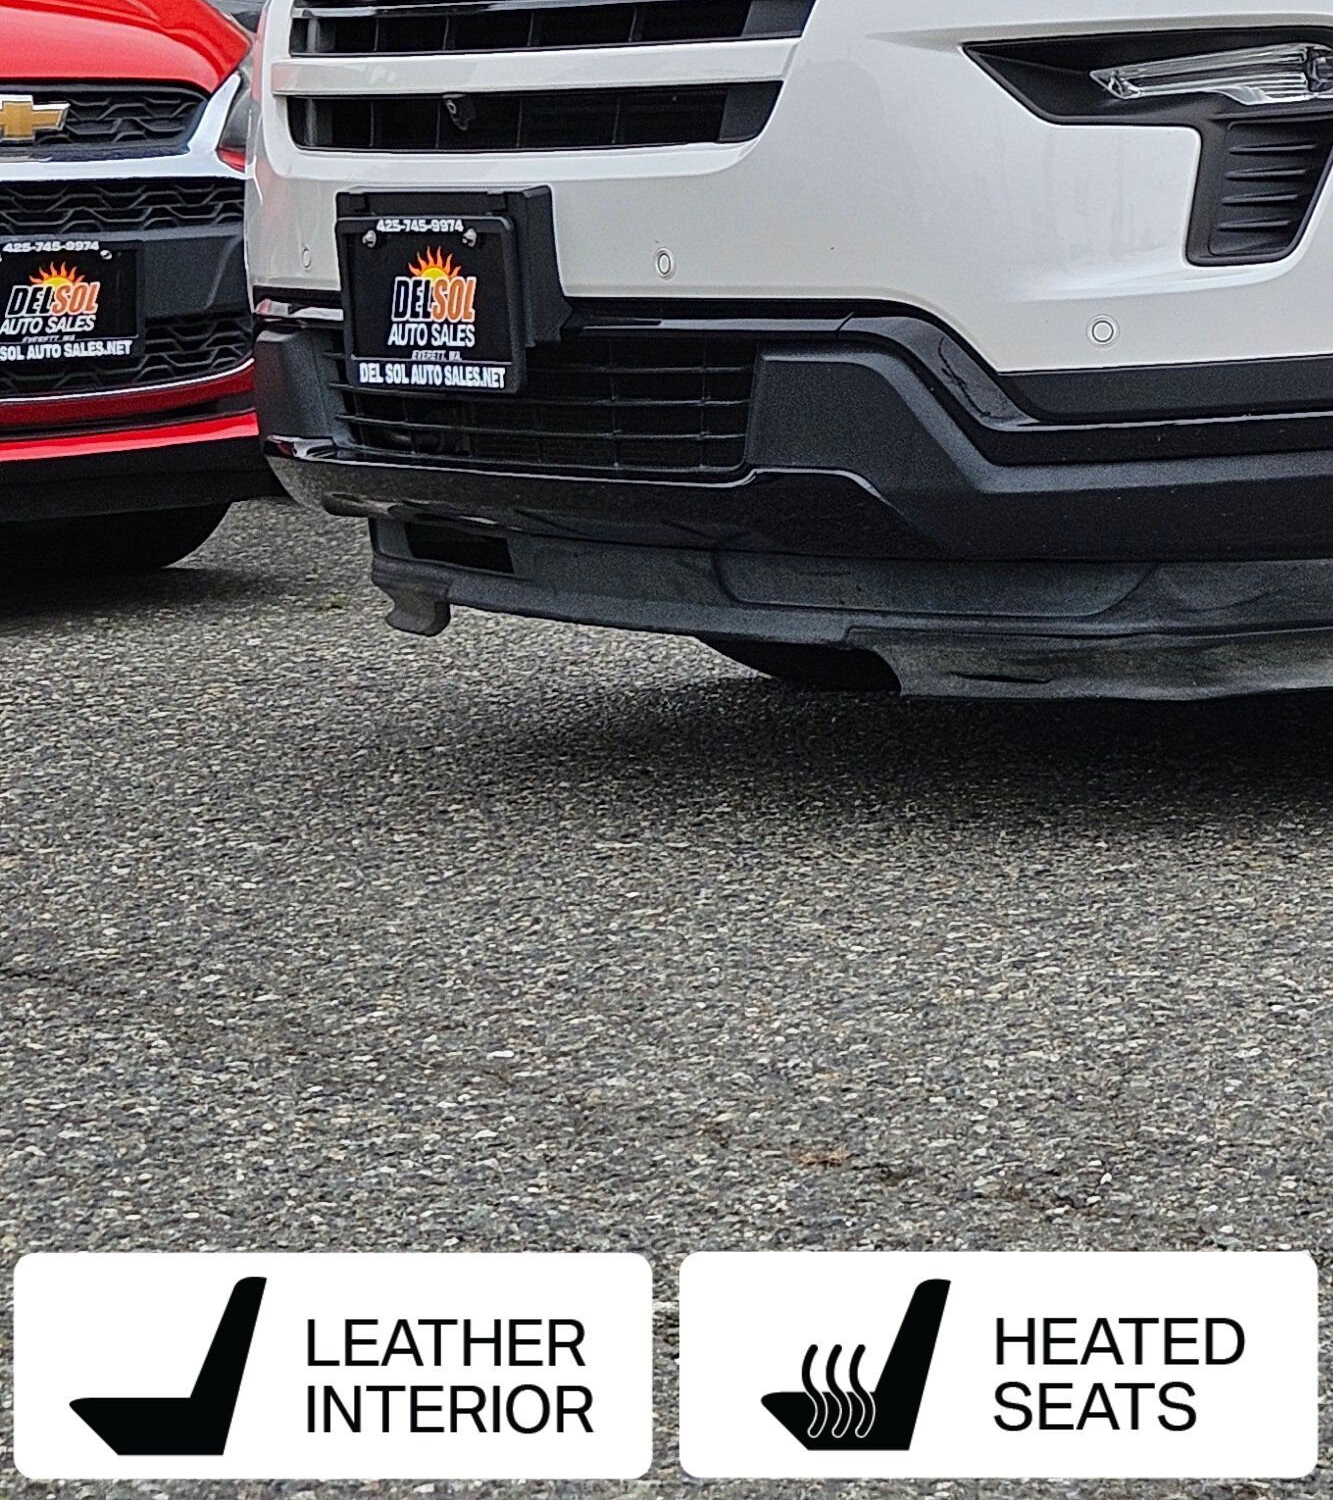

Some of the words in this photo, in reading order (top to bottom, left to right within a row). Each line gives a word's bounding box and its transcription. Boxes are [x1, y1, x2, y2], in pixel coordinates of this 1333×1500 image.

[376, 219, 465, 233] 425-745-9974
[0, 317, 43, 335] AUTO
[45, 315, 97, 334] SALES
[387, 323, 428, 347] AUTO
[430, 323, 476, 348] SALES
[0, 345, 25, 362] SOL
[26, 343, 61, 360] AUTO
[63, 340, 133, 358] SALES.NET
[359, 362, 384, 384] DEL
[385, 363, 409, 385] SOL
[411, 364, 443, 386] AUTO
[444, 365, 506, 389] SALES.NET
